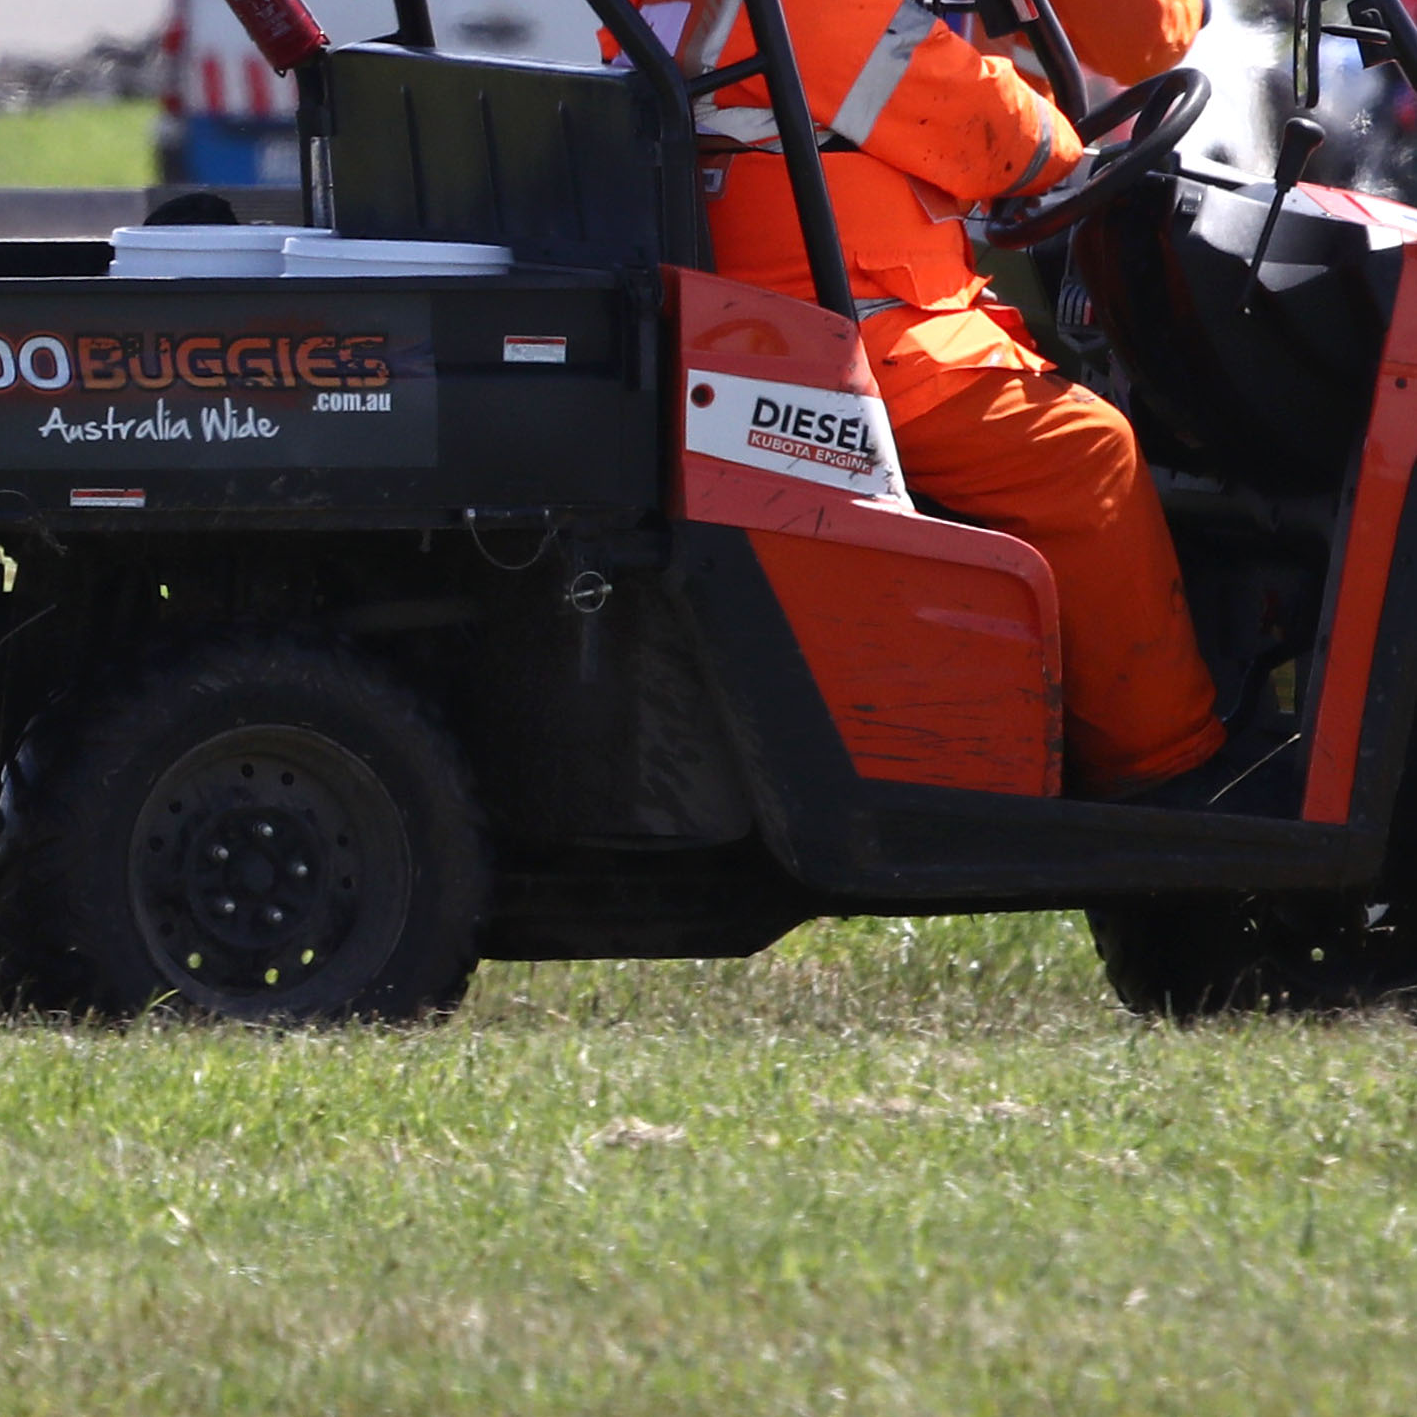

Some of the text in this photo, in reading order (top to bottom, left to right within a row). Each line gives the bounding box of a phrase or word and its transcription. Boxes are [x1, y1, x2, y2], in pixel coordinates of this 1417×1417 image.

[38, 396, 279, 444] Australia Wide
[312, 392, 392, 413] .com.au
[750, 396, 876, 455] DIESEL
[750, 431, 812, 460] KUBOTA
